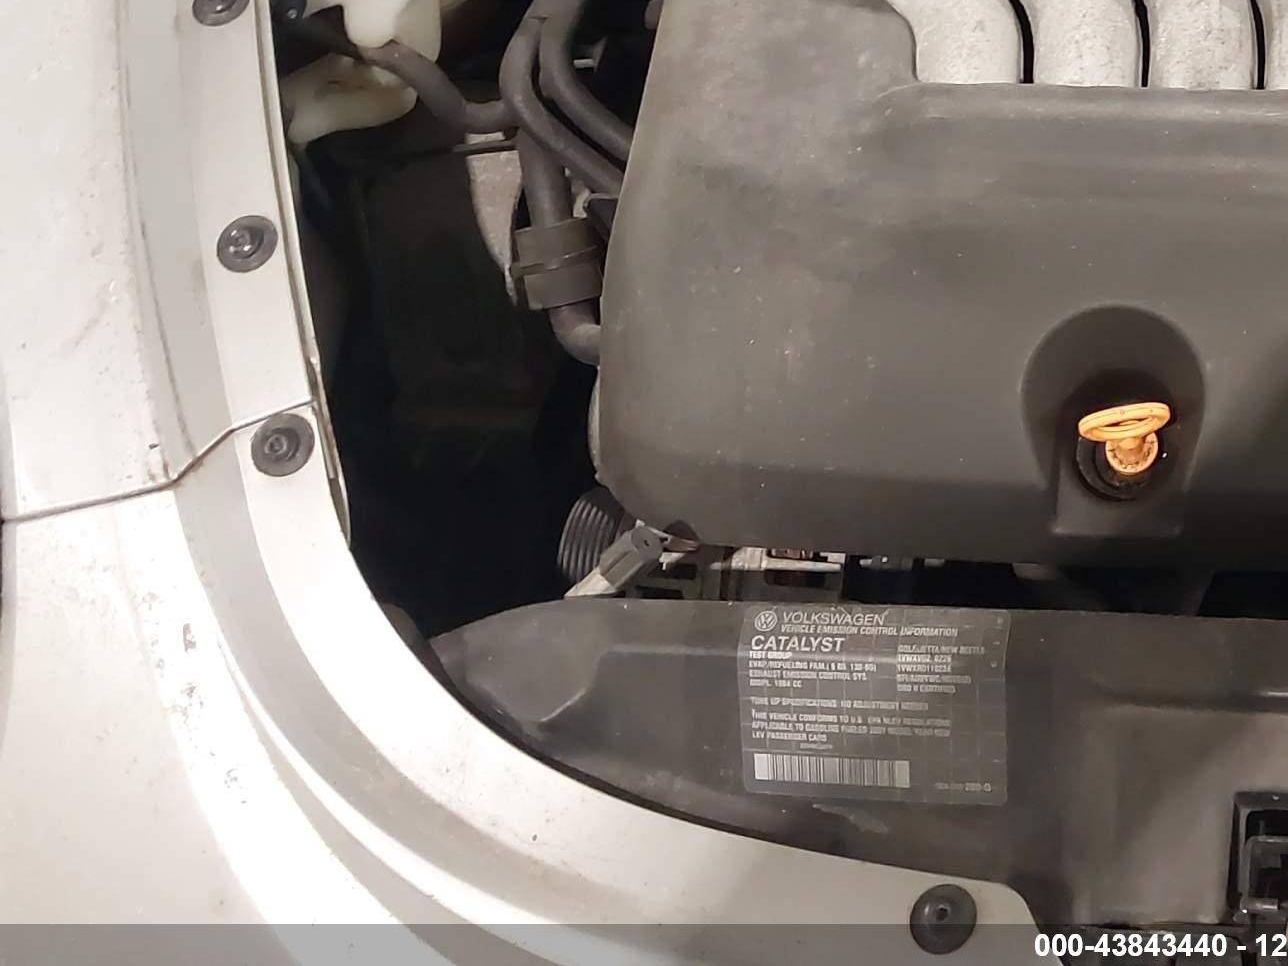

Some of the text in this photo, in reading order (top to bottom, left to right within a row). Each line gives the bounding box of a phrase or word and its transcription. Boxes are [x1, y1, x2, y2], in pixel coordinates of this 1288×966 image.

[782, 612, 886, 626] VOLKSWAGEN
[781, 624, 959, 637] VEHICLE EMISSION CONTROL INFORMATION
[751, 635, 846, 652] CATALYST
